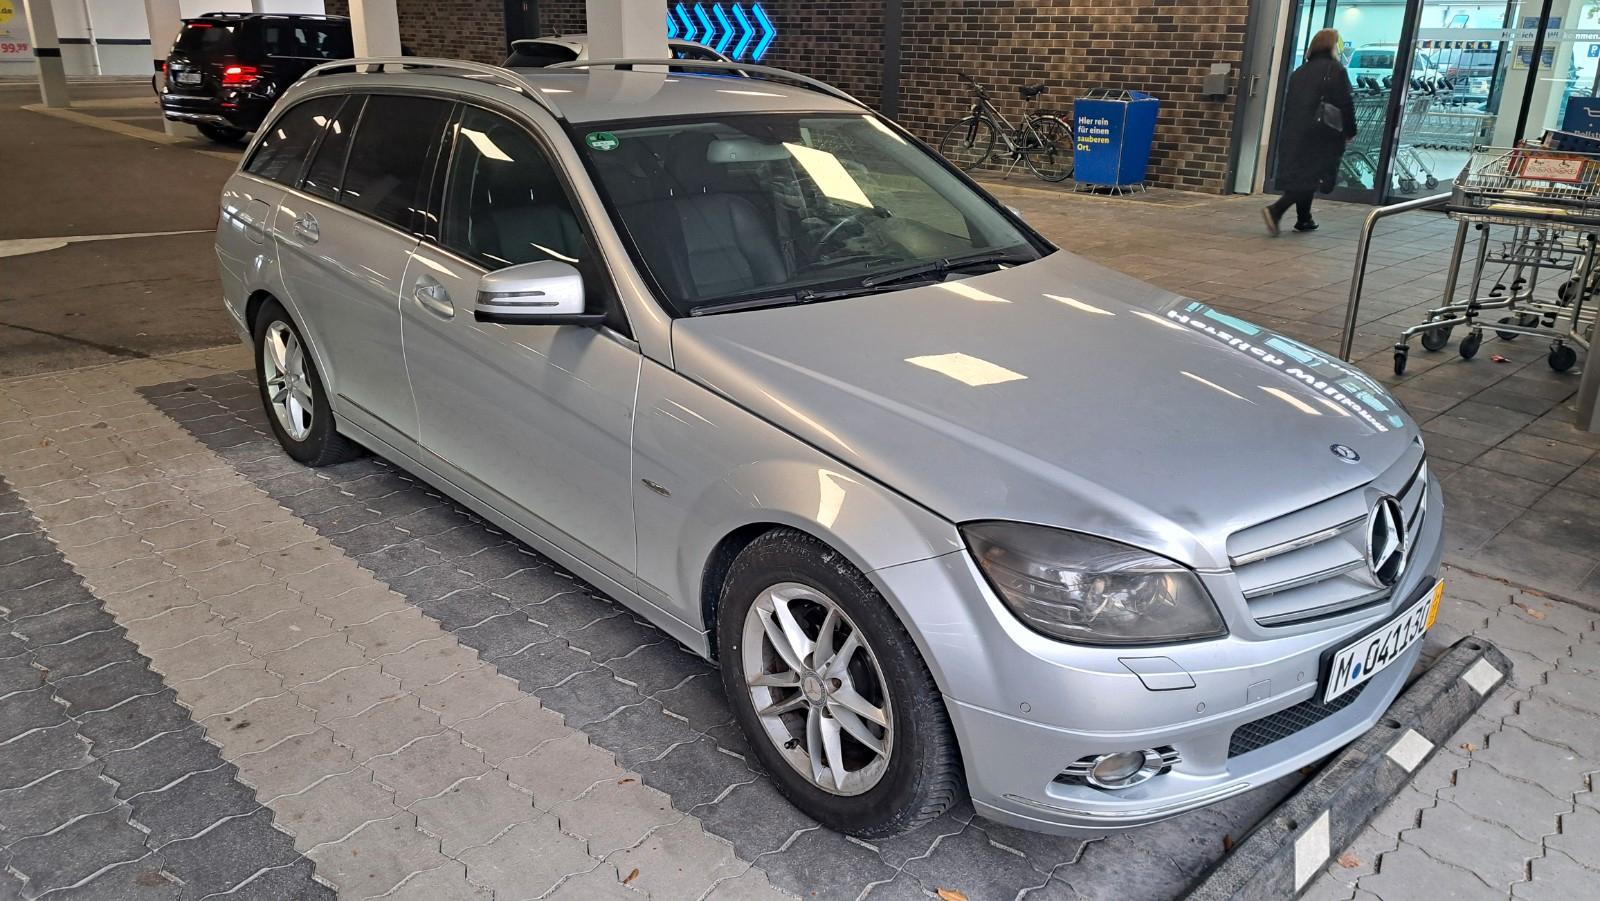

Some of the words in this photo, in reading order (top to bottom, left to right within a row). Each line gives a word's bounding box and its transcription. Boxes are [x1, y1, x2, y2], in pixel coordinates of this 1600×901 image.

[1078, 116, 1093, 125] Hier
[1094, 117, 1108, 125] rein
[1078, 125, 1089, 133] für
[1089, 126, 1109, 134] einen
[1077, 135, 1109, 143] sauberen
[1077, 143, 1090, 151] Ort.
[1333, 652, 1355, 694] M
[1363, 598, 1431, 676] 041130
